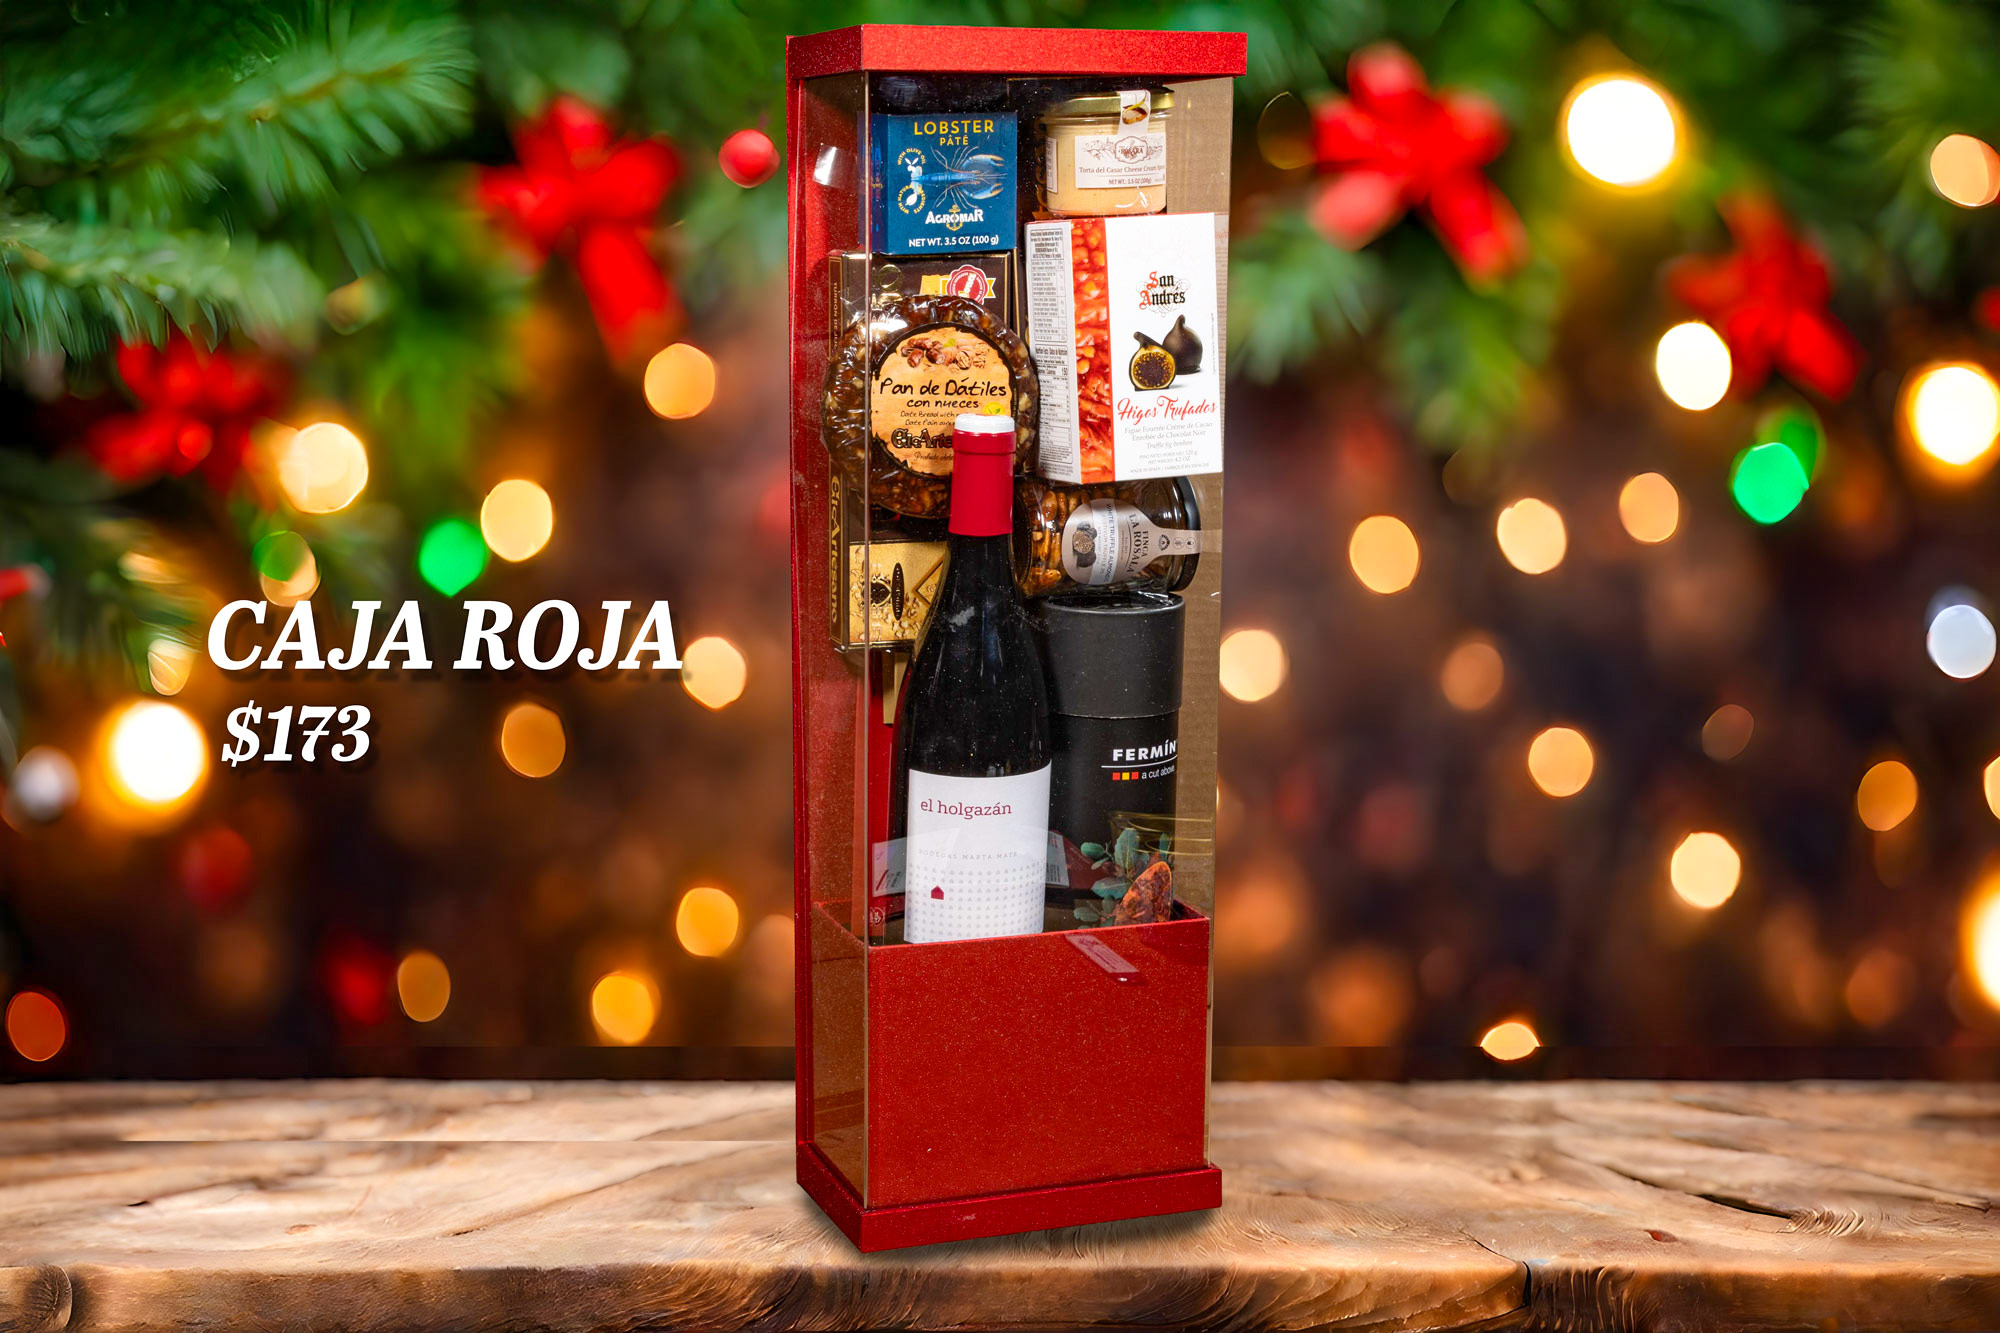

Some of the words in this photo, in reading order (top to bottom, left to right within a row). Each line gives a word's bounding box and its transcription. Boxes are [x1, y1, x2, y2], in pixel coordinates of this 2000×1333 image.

[914, 119, 994, 136] LOBSTER
[939, 135, 969, 146] PÂTÉ
[906, 148, 922, 156] OLIVE
[1079, 166, 1095, 174] Torta
[1095, 166, 1105, 174] del
[1124, 165, 1143, 173] Cheese
[908, 238, 926, 248] NET
[927, 237, 943, 247] WT.
[944, 236, 957, 246] 3.5
[958, 236, 971, 246] OZ
[971, 235, 990, 246] (100
[990, 235, 999, 246] g)
[1146, 270, 1175, 290] San
[1139, 286, 1186, 310] Andrés
[879, 377, 914, 395] Pan
[919, 379, 940, 396] de
[944, 377, 1007, 397] Dátiles
[906, 400, 931, 408] con
[934, 400, 979, 409] nueces
[1117, 397, 1157, 426] Higos
[1156, 395, 1216, 421] Trufados
[900, 410, 918, 418] Date
[918, 410, 939, 418] Bread
[939, 410, 955, 418] with
[1165, 431, 1192, 439] Chocolat
[1128, 513, 1140, 529] LA
[1126, 530, 1143, 574] ROSALA
[1141, 530, 1150, 558] FINCA
[1112, 739, 1177, 762] FERMÍN
[1141, 772, 1147, 780] a
[1148, 769, 1160, 779] cut
[920, 798, 934, 812] el
[937, 800, 1013, 820] holgazán
